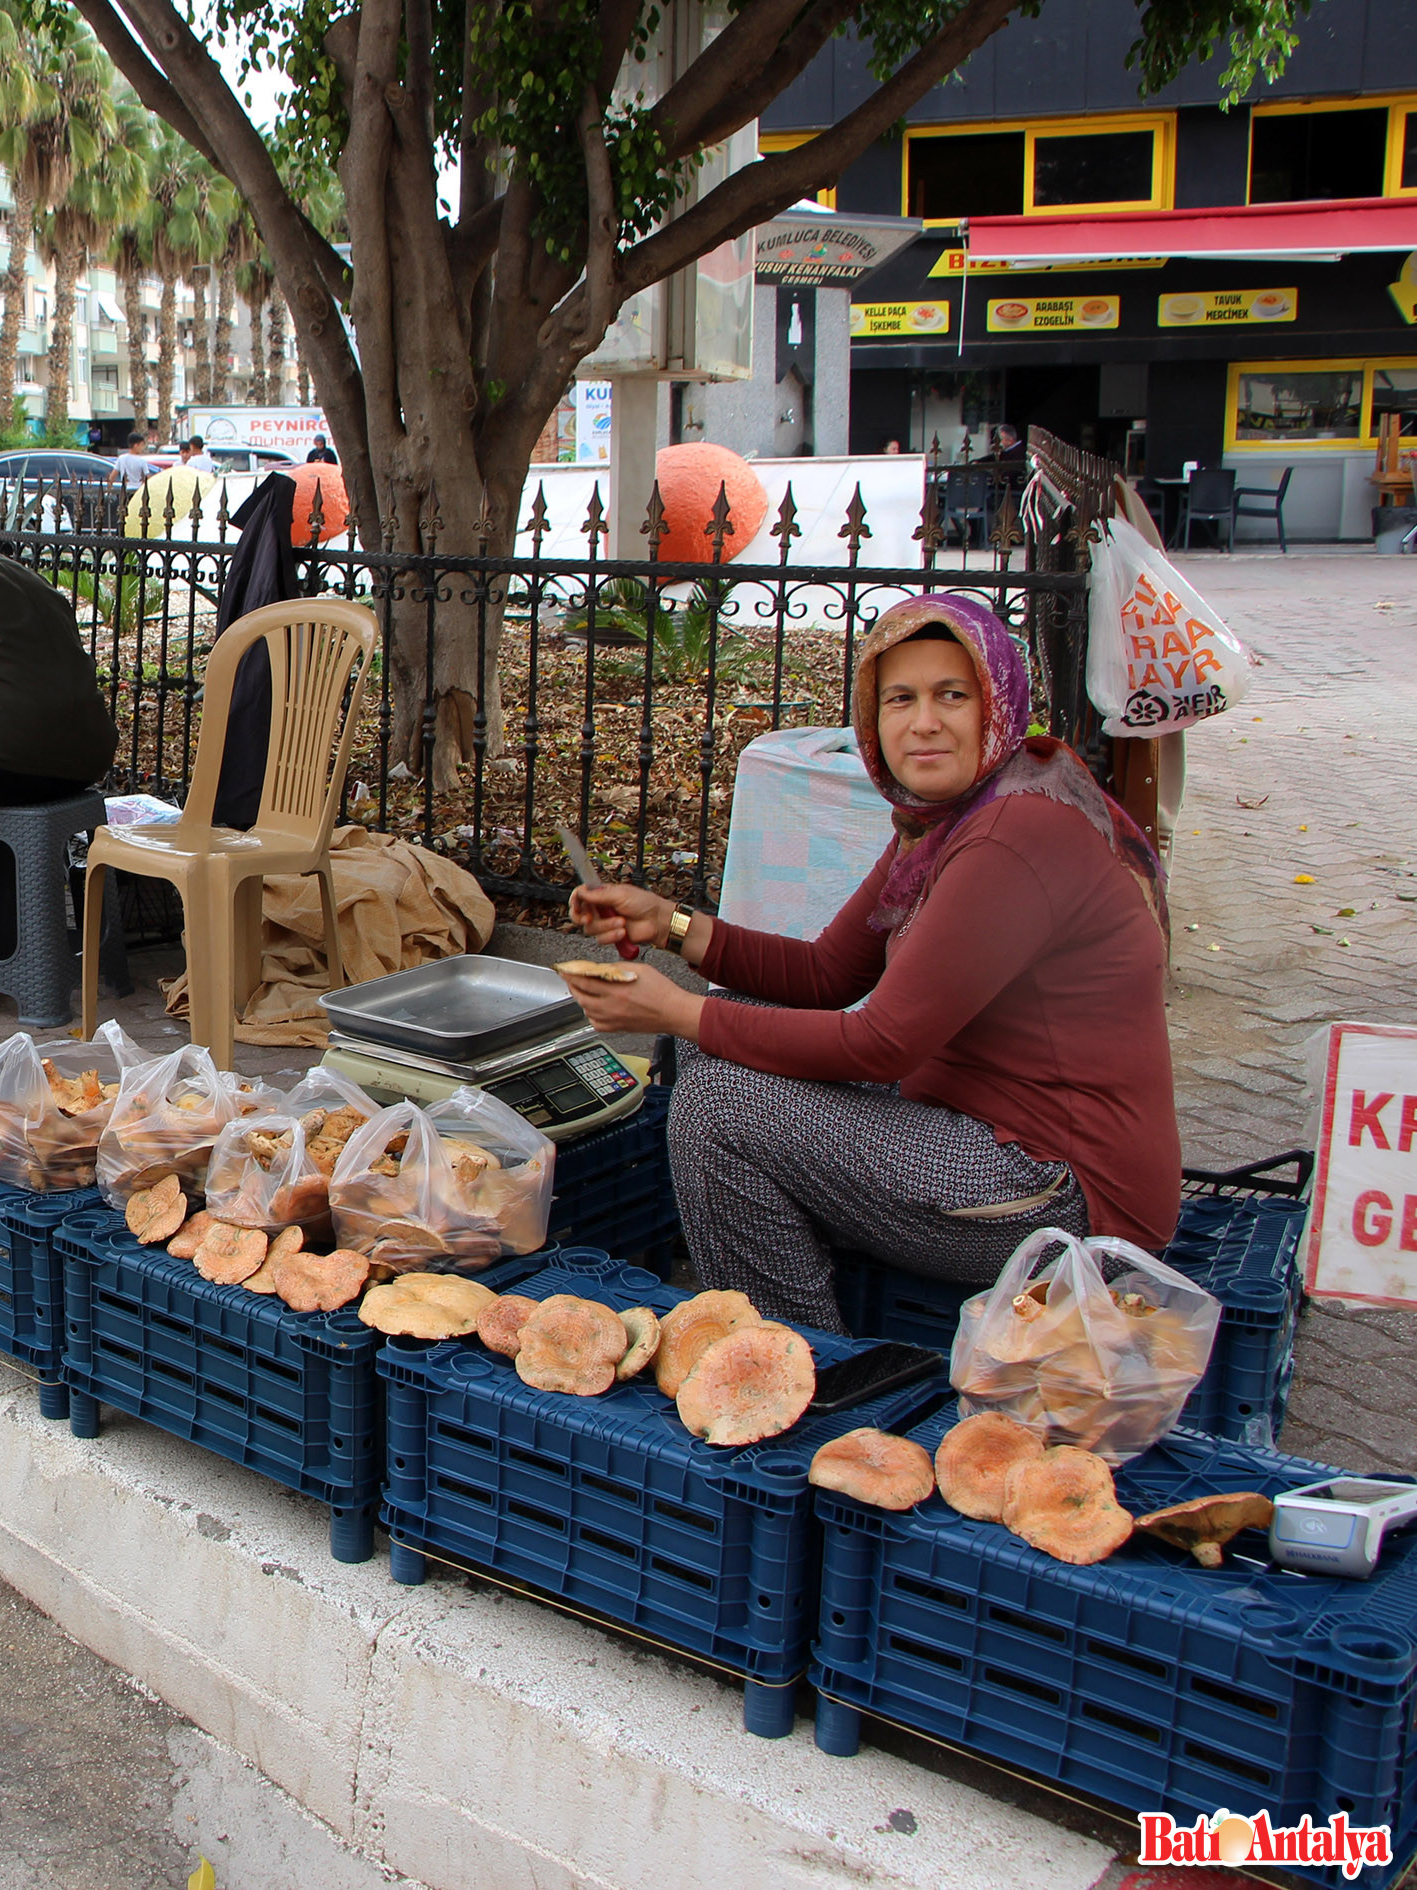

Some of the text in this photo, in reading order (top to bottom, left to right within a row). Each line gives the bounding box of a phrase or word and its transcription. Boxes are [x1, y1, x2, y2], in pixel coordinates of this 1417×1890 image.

[757, 229, 821, 254] KUMLUCA
[1214, 294, 1243, 306] TAVUK
[864, 306, 907, 318] KELLE PAÇA
[1034, 311, 1075, 326] EZOGELİN
[1206, 307, 1249, 321] MERCİMEK
